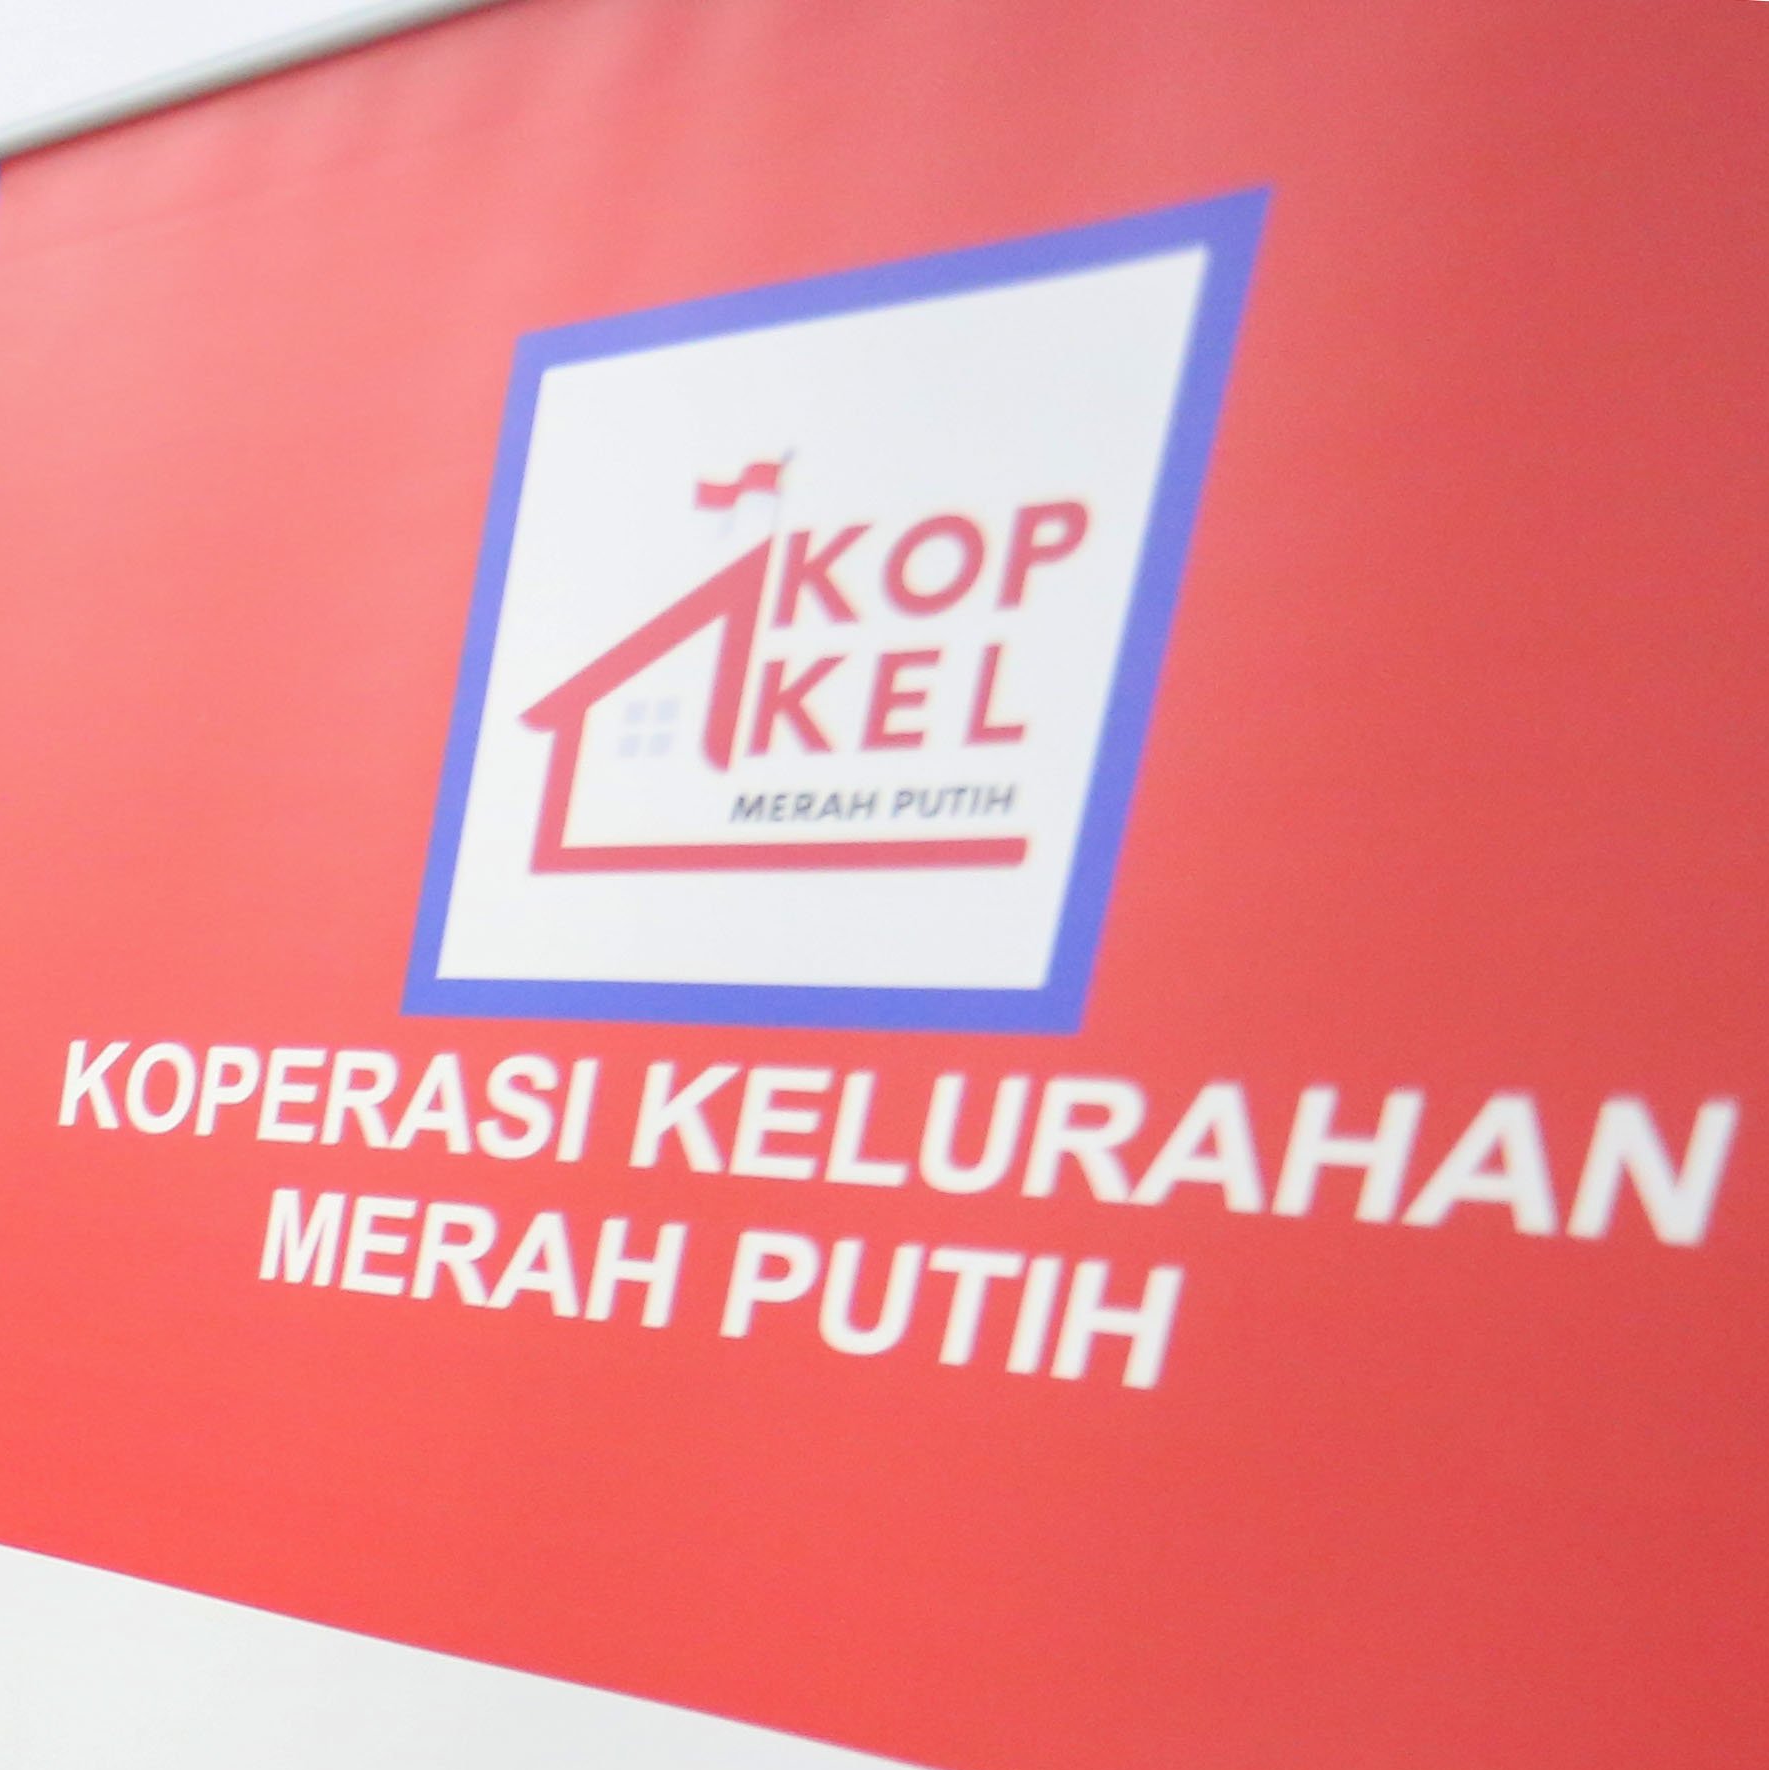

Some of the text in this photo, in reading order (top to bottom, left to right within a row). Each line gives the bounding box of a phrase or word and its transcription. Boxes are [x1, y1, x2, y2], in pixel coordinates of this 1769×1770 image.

[771, 499, 1090, 628] KOP
[749, 642, 1026, 757] KEL
[729, 784, 1018, 824] MERAH PUTIH
[57, 1039, 1738, 1249] KOPERASI KELURAHAN
[259, 1187, 1183, 1391] MERAH PUTIH
